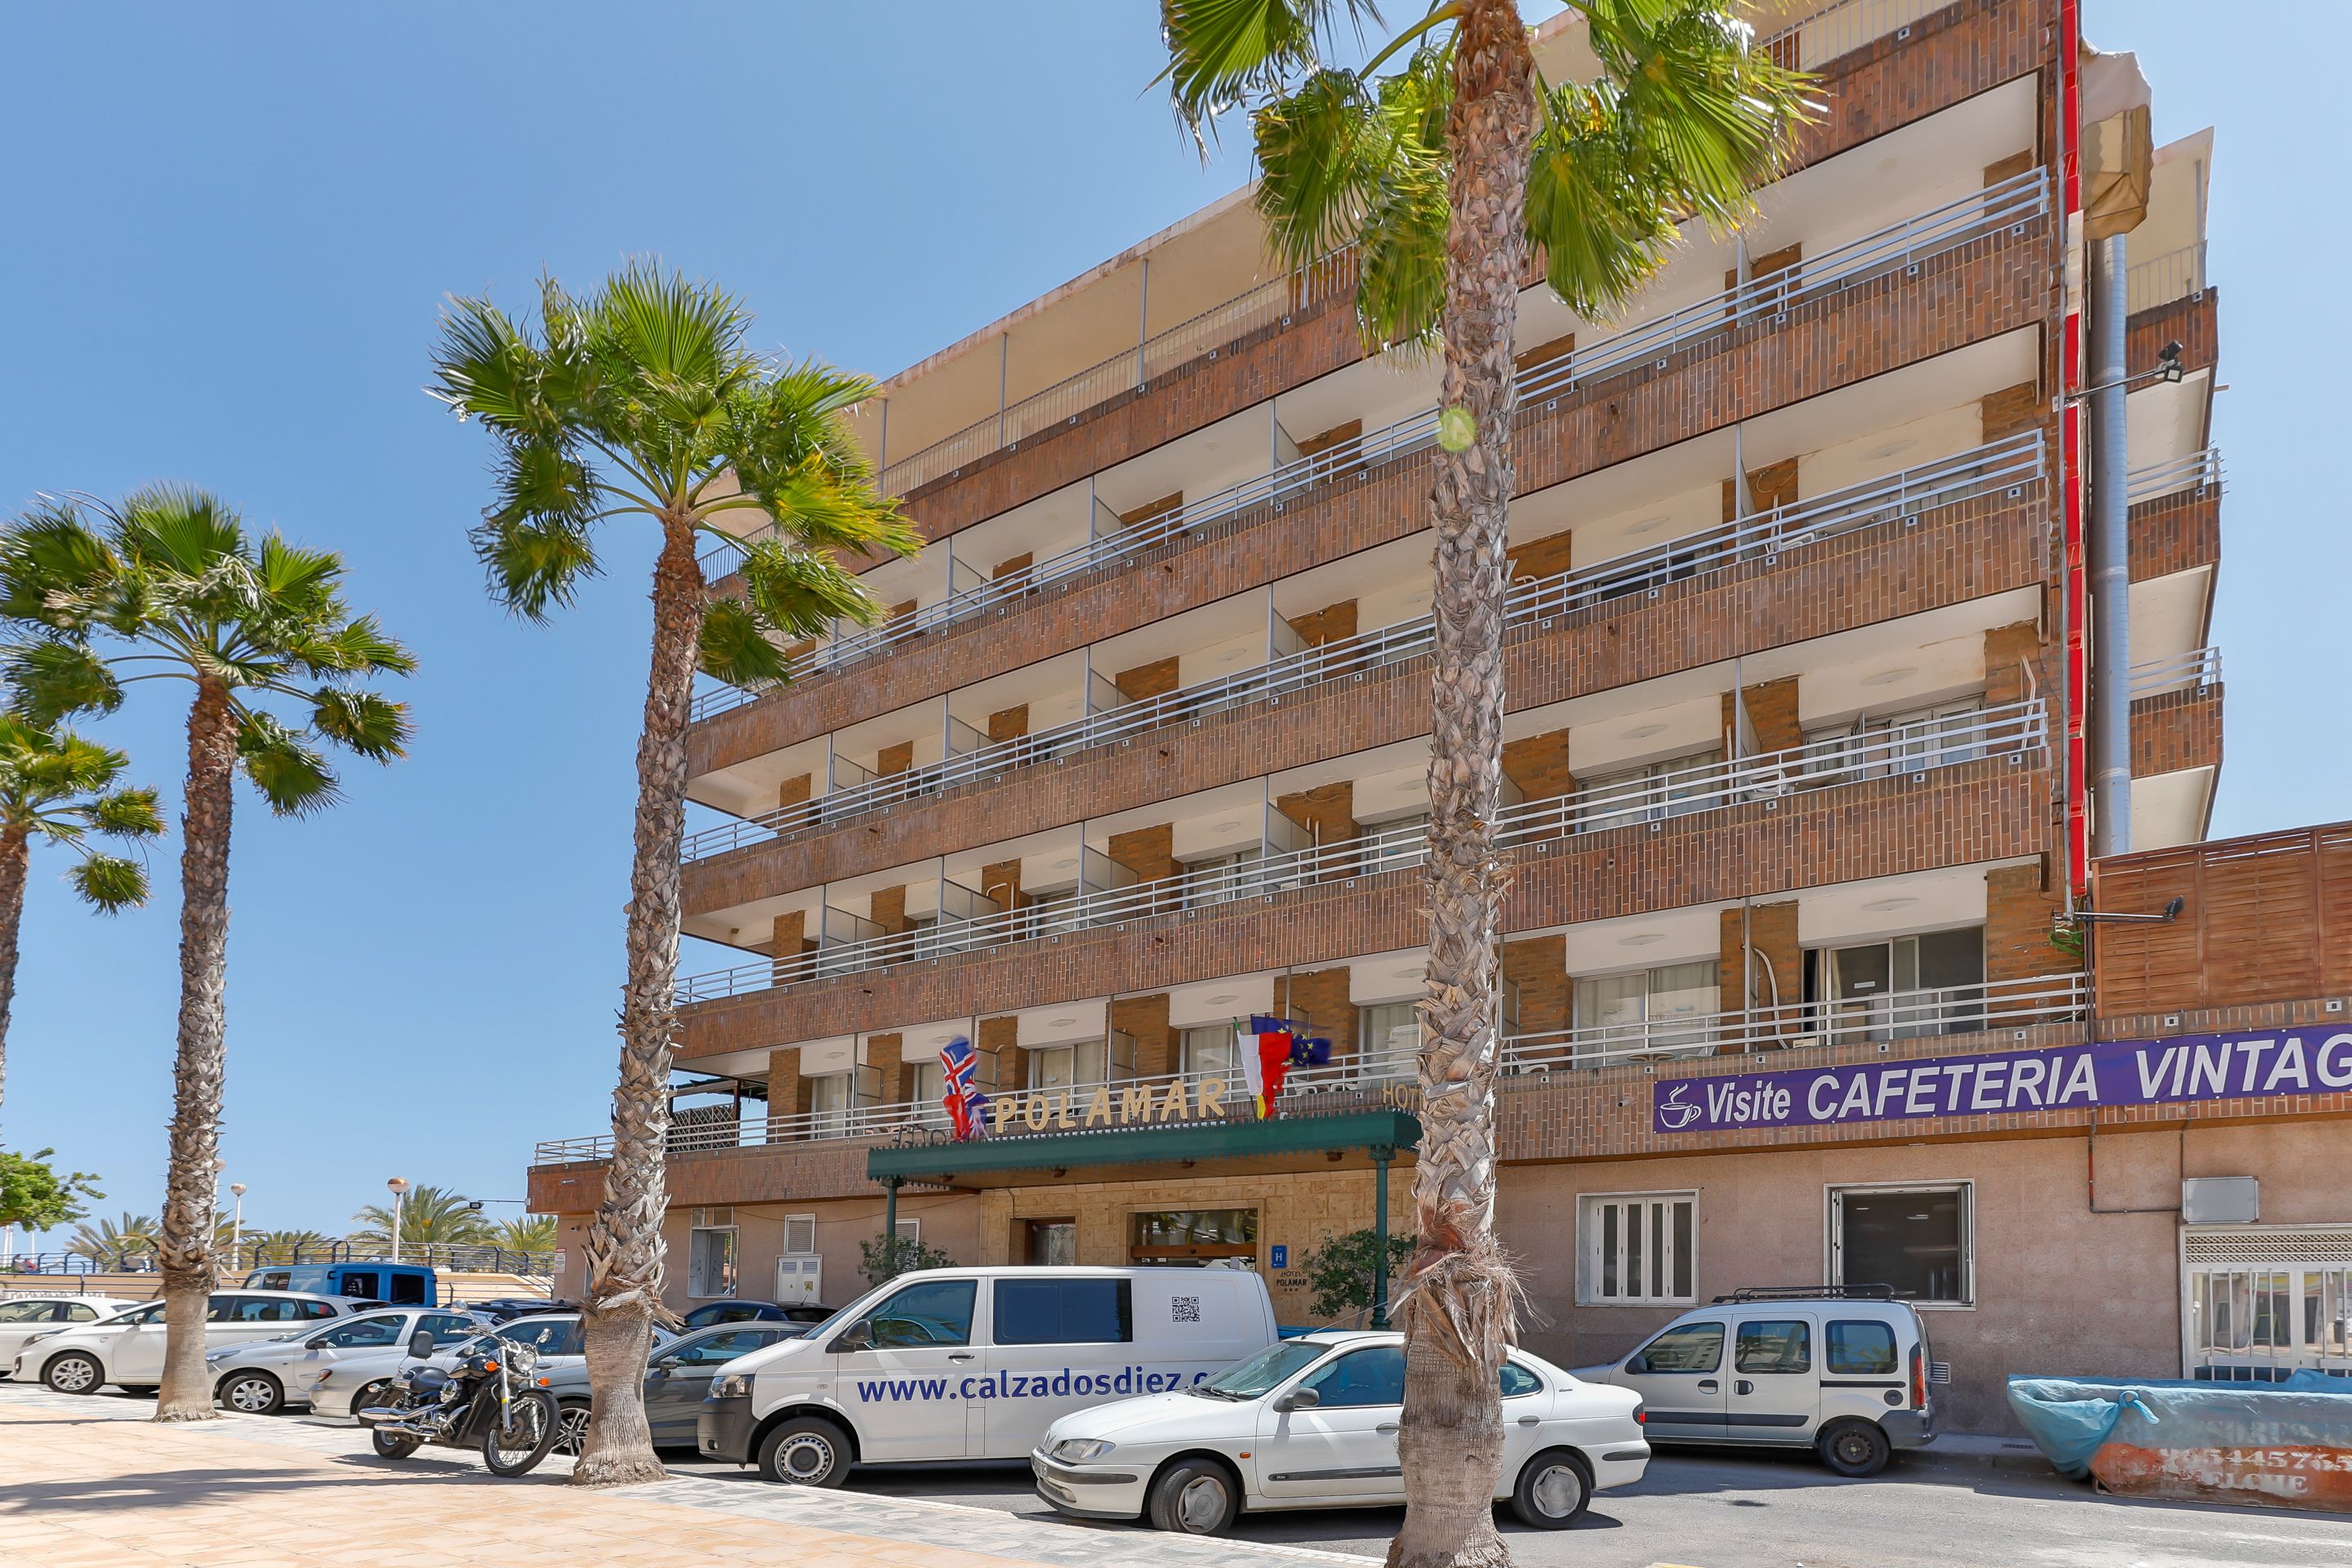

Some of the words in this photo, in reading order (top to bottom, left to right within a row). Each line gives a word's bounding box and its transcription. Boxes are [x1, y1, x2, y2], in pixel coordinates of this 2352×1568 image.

[1383, 1077, 1423, 1111] HOT
[1707, 1080, 1791, 1125] Visite
[1807, 1053, 2098, 1120] CAFETERIA
[2136, 1033, 2352, 1099] VINTAG
[996, 1078, 1225, 1134] POLAMAR
[1276, 1252, 1283, 1262] H
[1276, 1279, 1307, 1287] POLAMAR
[857, 1366, 1217, 1403] www.calzadosdiez.c
